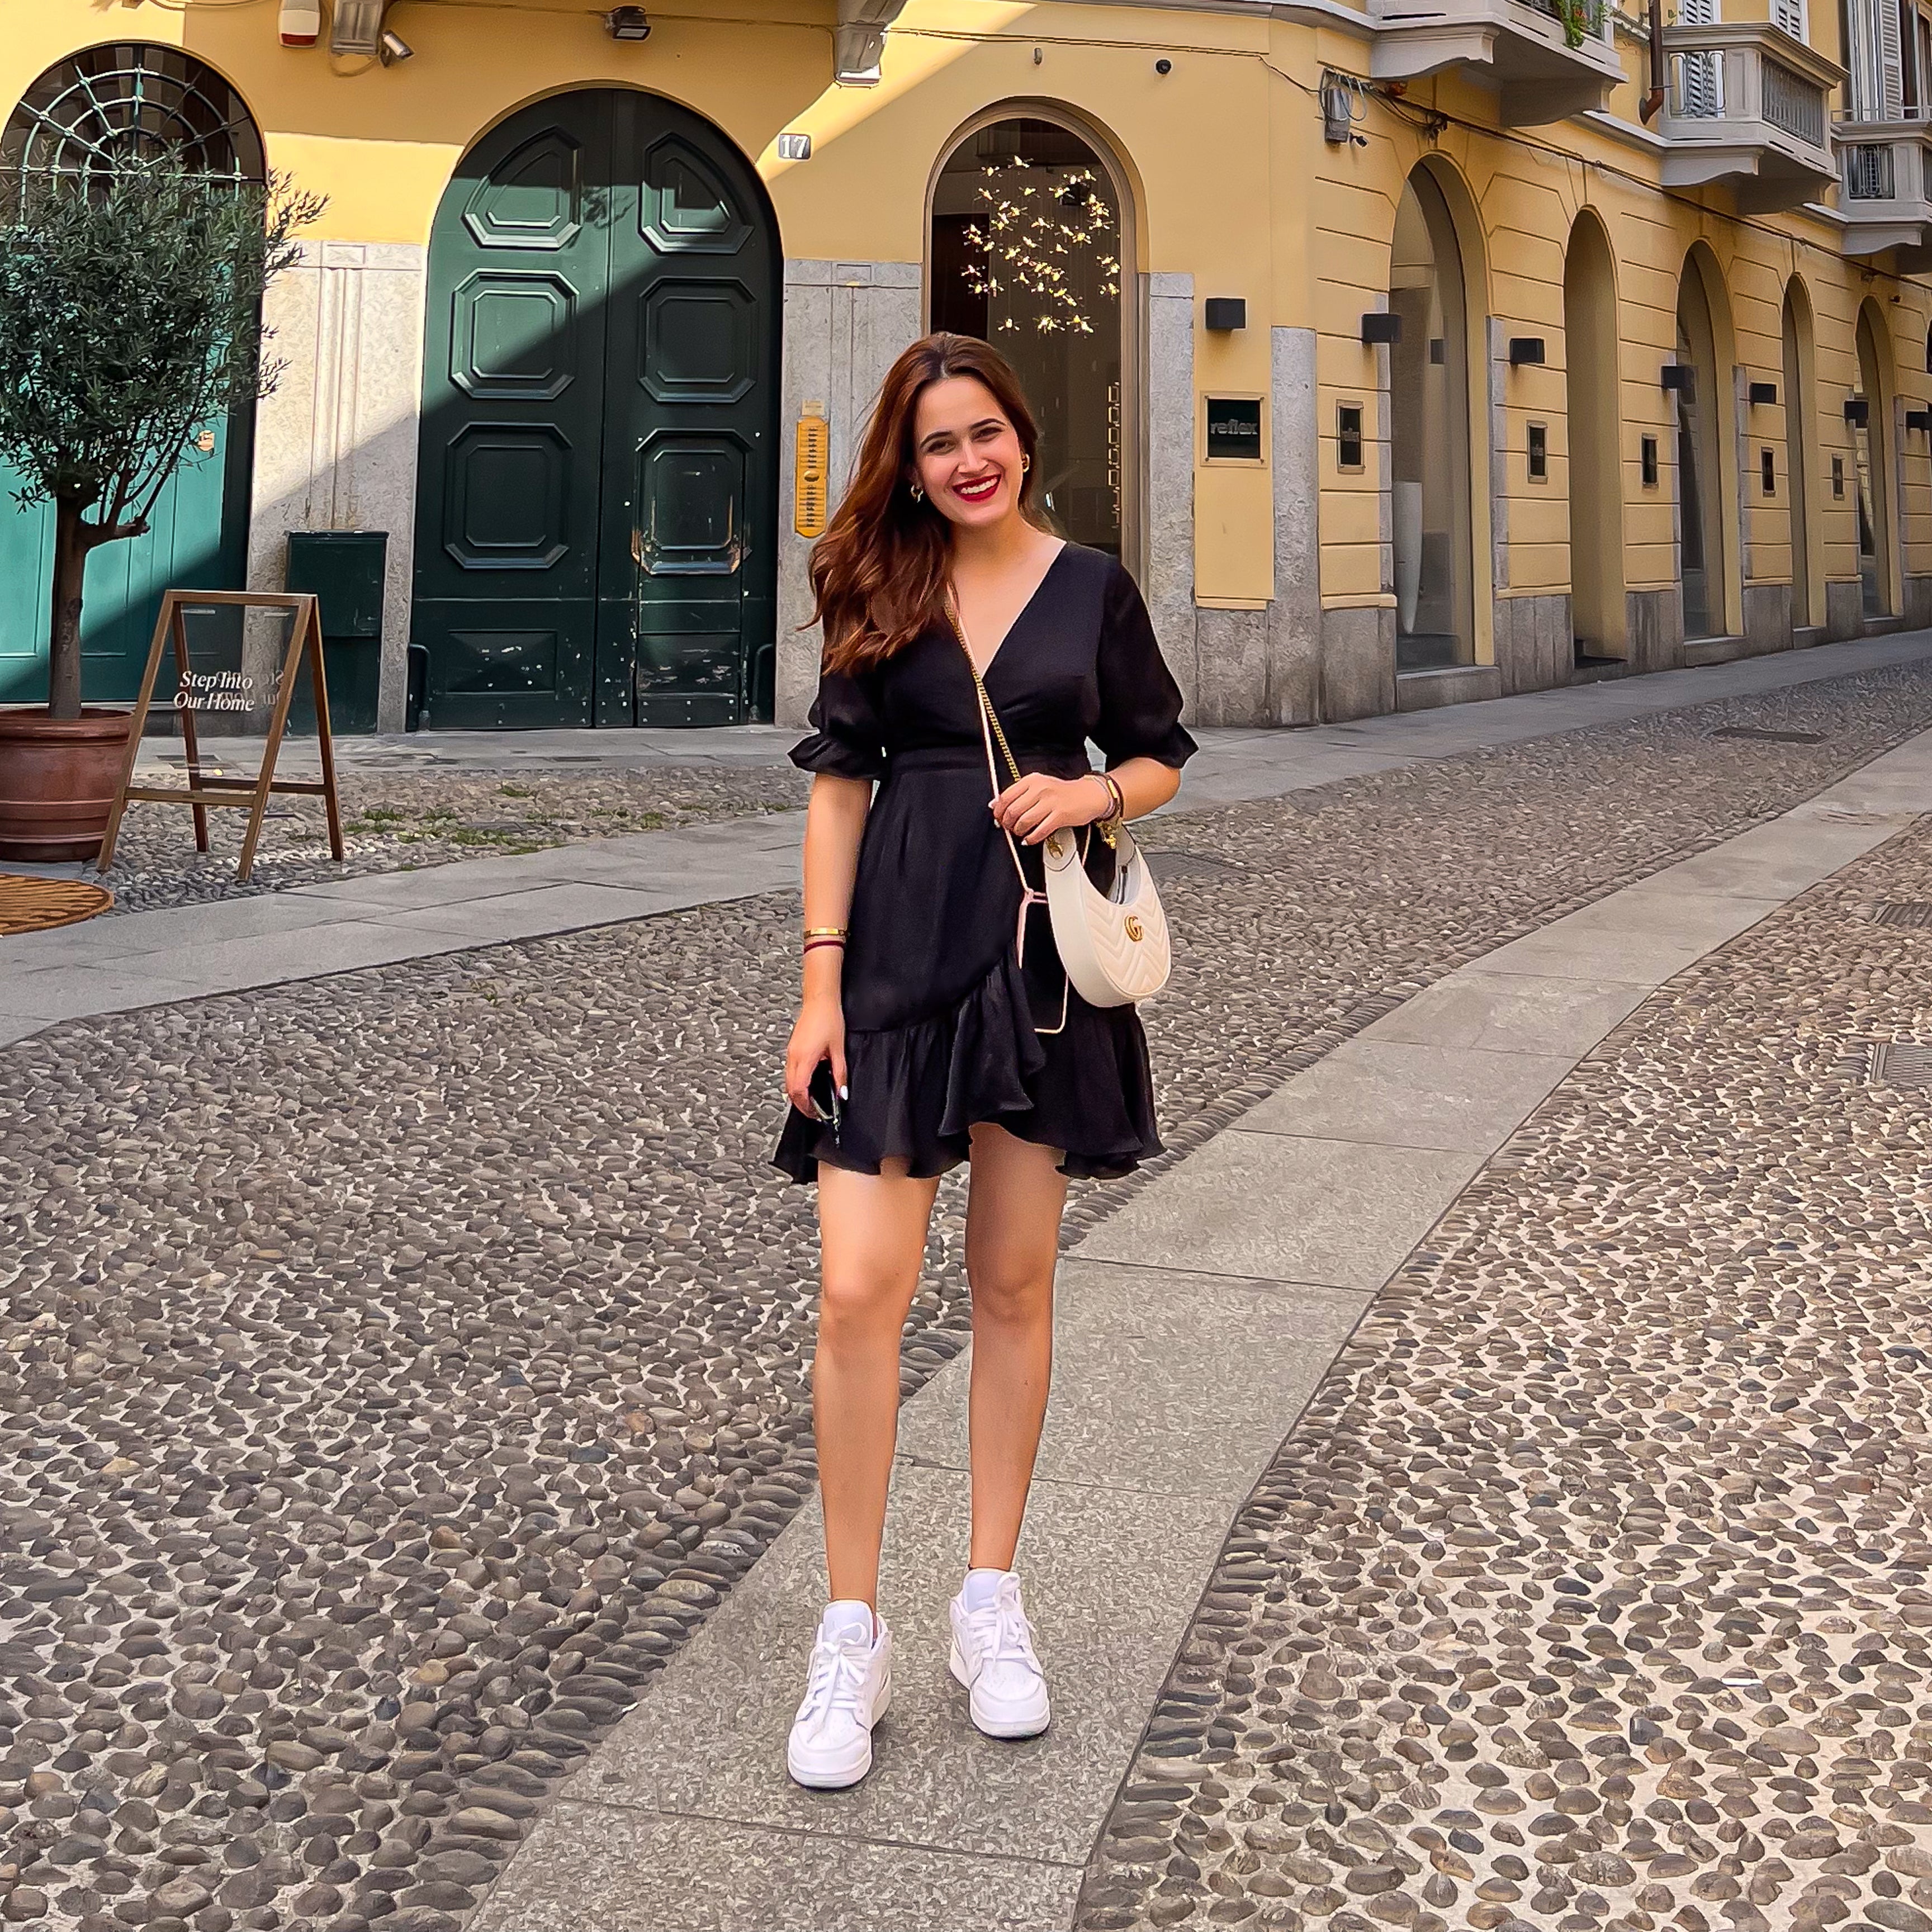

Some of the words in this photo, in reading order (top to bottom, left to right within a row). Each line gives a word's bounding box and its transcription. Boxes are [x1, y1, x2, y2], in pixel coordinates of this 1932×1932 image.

[782, 135, 808, 158] 17
[179, 670, 217, 692] Step
[220, 671, 253, 690] Into
[173, 691, 205, 709] Our
[206, 693, 255, 711] Home
